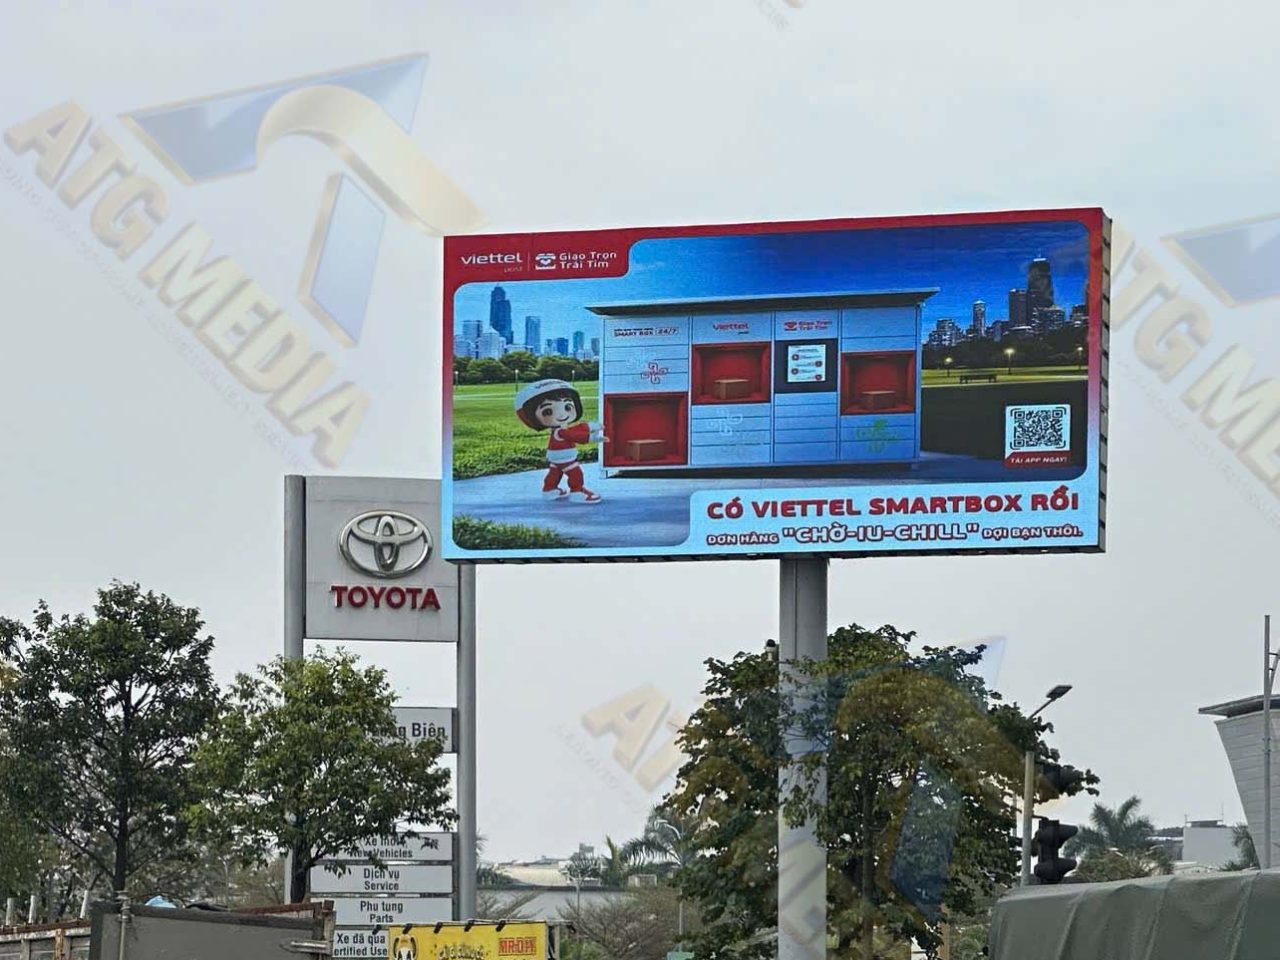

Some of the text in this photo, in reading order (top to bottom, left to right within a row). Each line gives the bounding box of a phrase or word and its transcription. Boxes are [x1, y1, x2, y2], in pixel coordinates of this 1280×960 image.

[461, 252, 523, 265] viettel
[559, 251, 586, 261] Giao
[587, 259, 609, 269] Tim
[707, 496, 744, 519] CÓ
[751, 498, 861, 518] VIETTEL
[868, 493, 1023, 516] SMARTBOX
[739, 531, 779, 545] HÀNG
[330, 585, 441, 610] TOYOTA
[412, 722, 446, 738] Biên
[365, 880, 400, 891] Service
[370, 913, 394, 923] Parts
[337, 932, 350, 945] Xe
[334, 946, 388, 956] ertified Use
